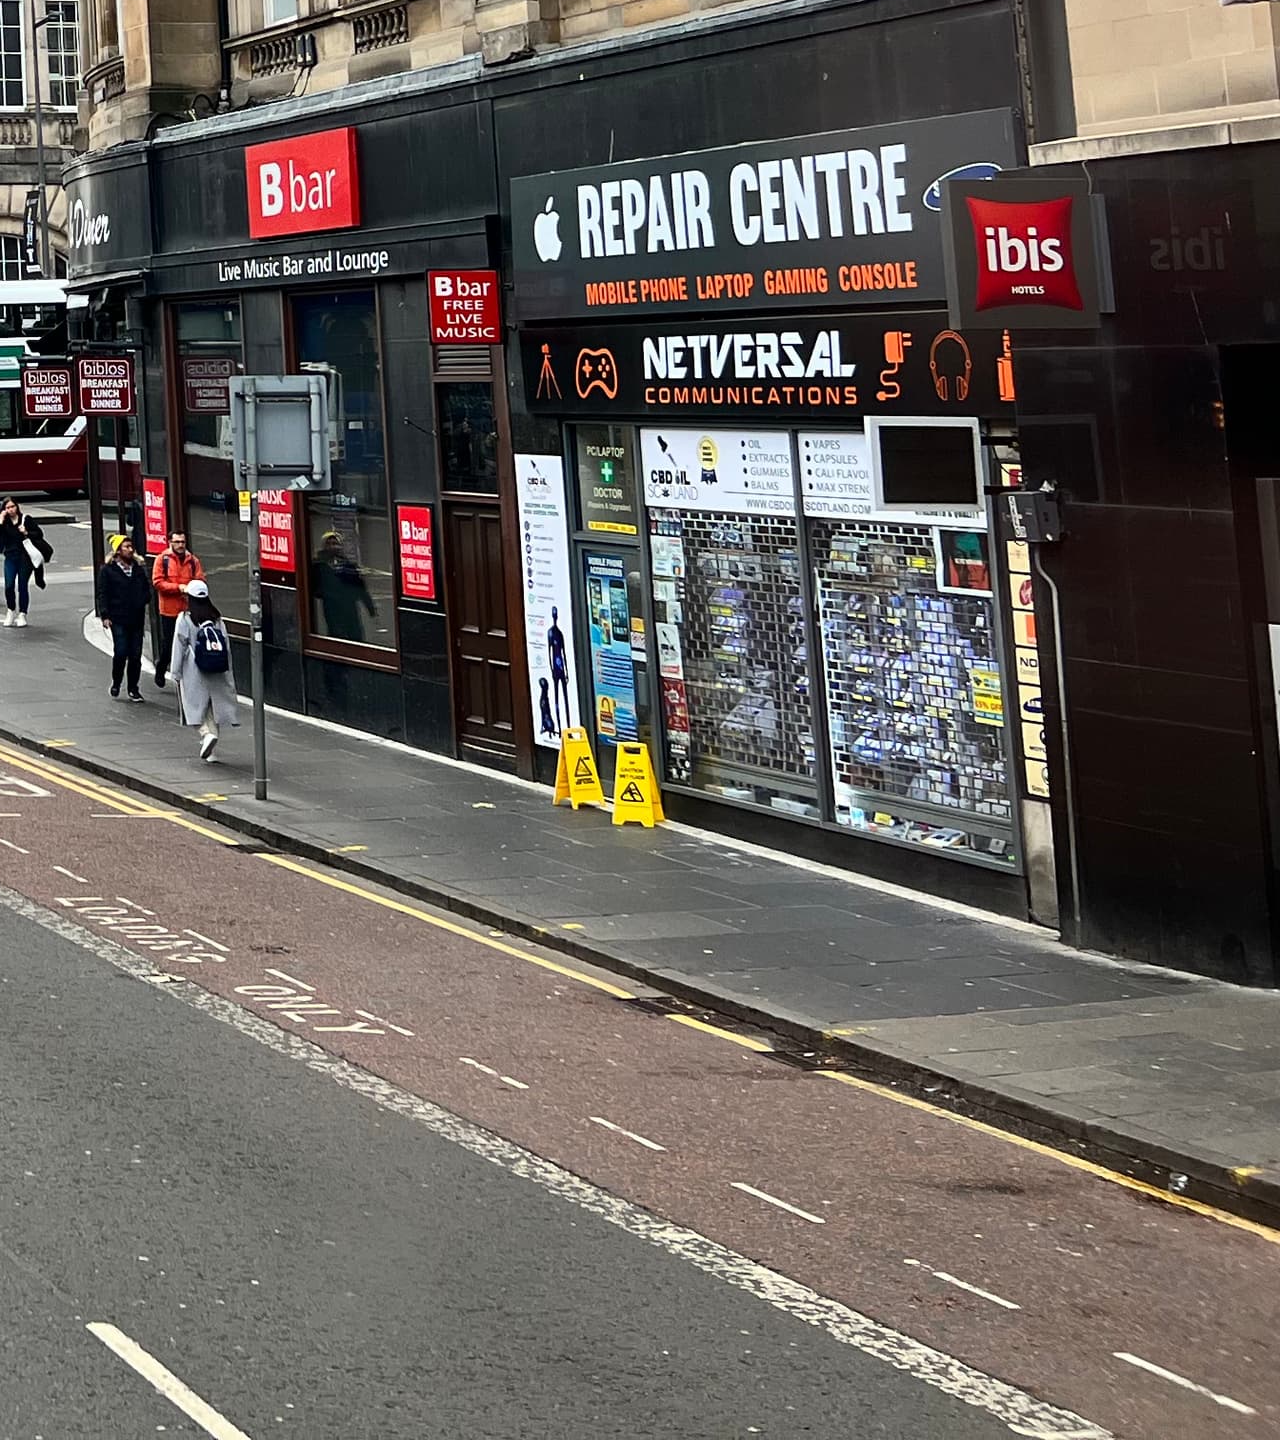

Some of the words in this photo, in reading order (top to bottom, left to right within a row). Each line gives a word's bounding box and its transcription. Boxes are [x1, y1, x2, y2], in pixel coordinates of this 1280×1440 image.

[260, 162, 284, 218] B
[288, 159, 336, 213] bar
[577, 170, 715, 258] REPAIR
[729, 144, 913, 246] CENTRE
[74, 198, 111, 249] Diner
[984, 226, 1064, 273] ibis
[218, 261, 241, 282] Live
[243, 257, 280, 279] Music
[282, 255, 305, 276] Bar
[306, 250, 333, 274] and
[336, 249, 389, 275] Lounge
[434, 276, 453, 297] B
[456, 276, 491, 297] bar
[585, 279, 639, 306] MOBILE
[640, 276, 689, 302] PHONE
[696, 272, 754, 300] LAPTOP
[763, 267, 828, 296] GAMING
[838, 261, 918, 292] CONSOLE
[1011, 285, 1045, 295] HOTELS
[443, 300, 484, 311] FREE
[446, 313, 483, 325] LIVE
[436, 327, 496, 338] MUSIC
[643, 330, 856, 380] NETVERSAL
[83, 362, 126, 376] biblos
[28, 372, 66, 385] biblos
[81, 377, 129, 389] BREAKFAST
[35, 395, 62, 405] LUNCH
[92, 389, 120, 399] LUNCH
[645, 386, 858, 406] COMMUNICATIONS
[34, 403, 64, 413] DINNER
[91, 398, 122, 409] DINNER
[747, 439, 762, 450] OIL
[812, 439, 841, 450] VAPES
[748, 453, 790, 465] EXTRACTS
[812, 453, 859, 465] CAPSULES
[650, 469, 673, 485] CBD
[750, 467, 790, 478] GUMMIES
[815, 467, 835, 478] CALI
[751, 480, 779, 491] BALMS
[816, 481, 836, 492] MAX
[593, 486, 624, 500] DOCTOR
[400, 520, 411, 540] B
[411, 521, 429, 541] bar
[233, 983, 385, 1035] ONLY
